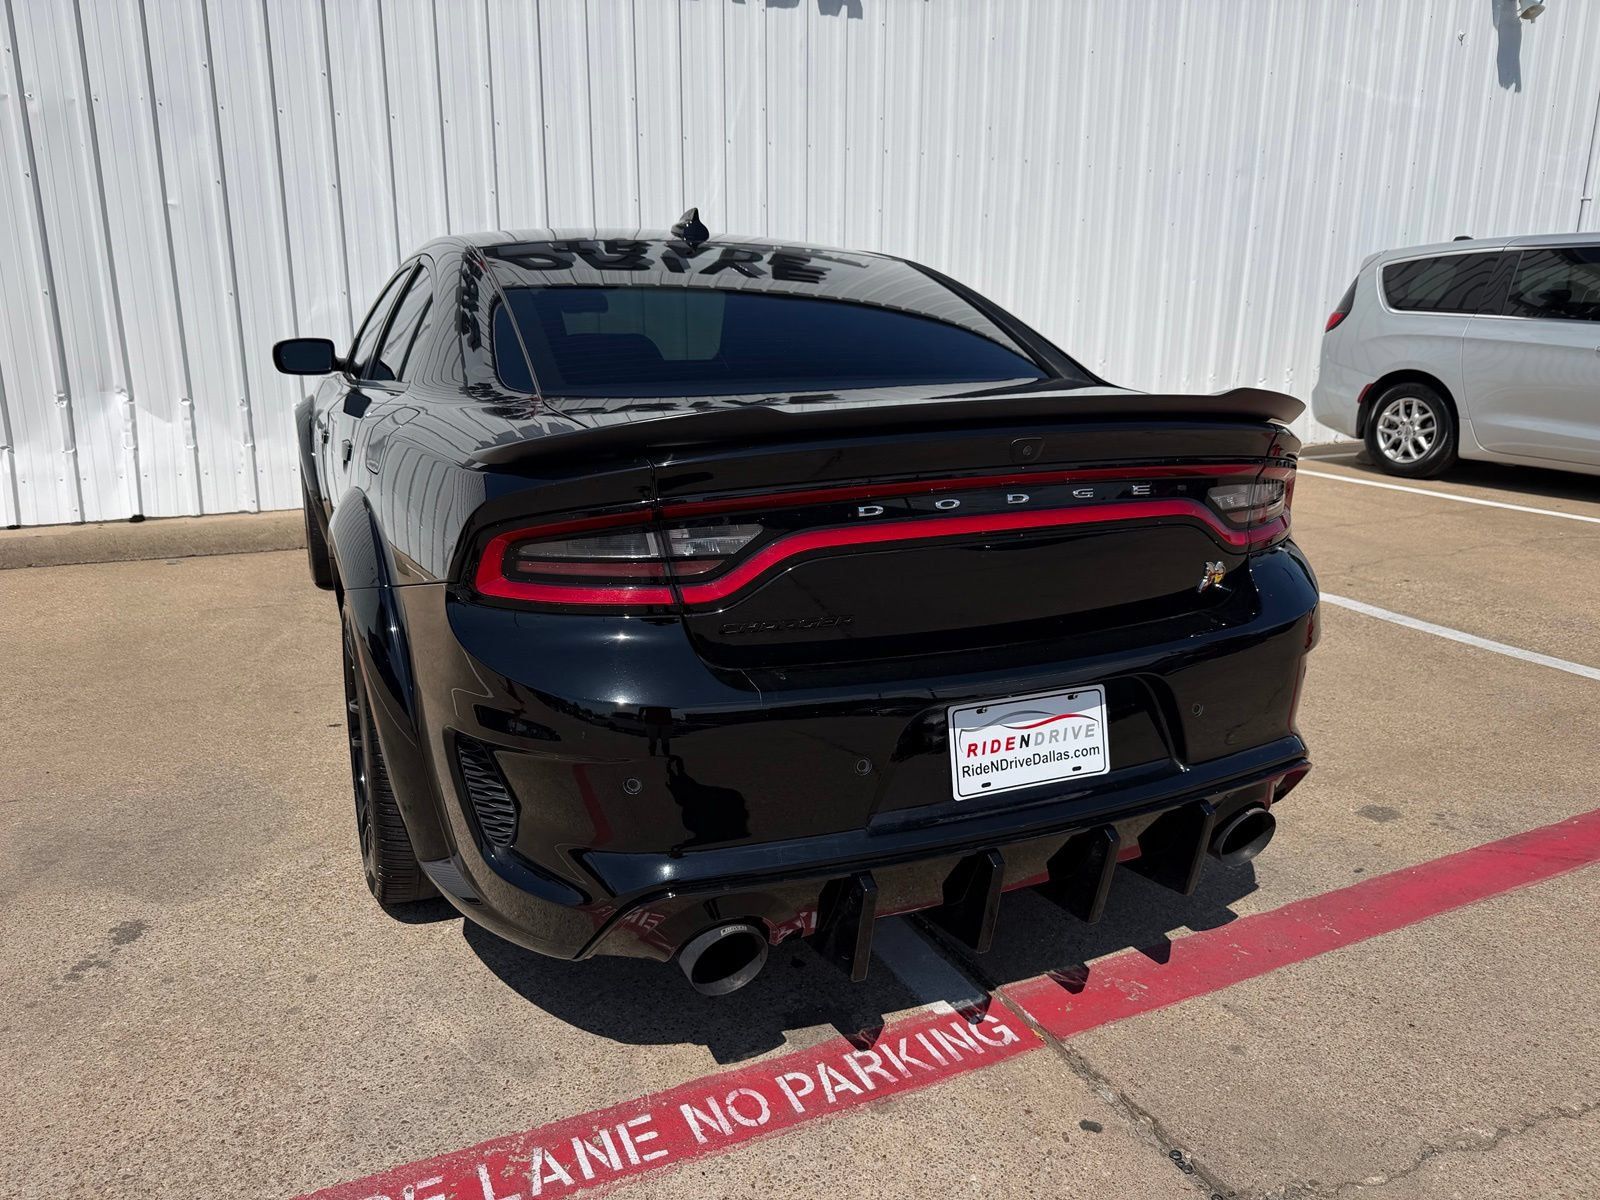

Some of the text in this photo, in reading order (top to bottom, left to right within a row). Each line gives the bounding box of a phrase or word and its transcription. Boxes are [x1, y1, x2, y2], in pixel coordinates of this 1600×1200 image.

[857, 484, 1151, 518] DODGE
[962, 746, 1100, 778] RideNDriveDallas.com
[478, 1014, 1020, 1200] LANE NO PARKING
